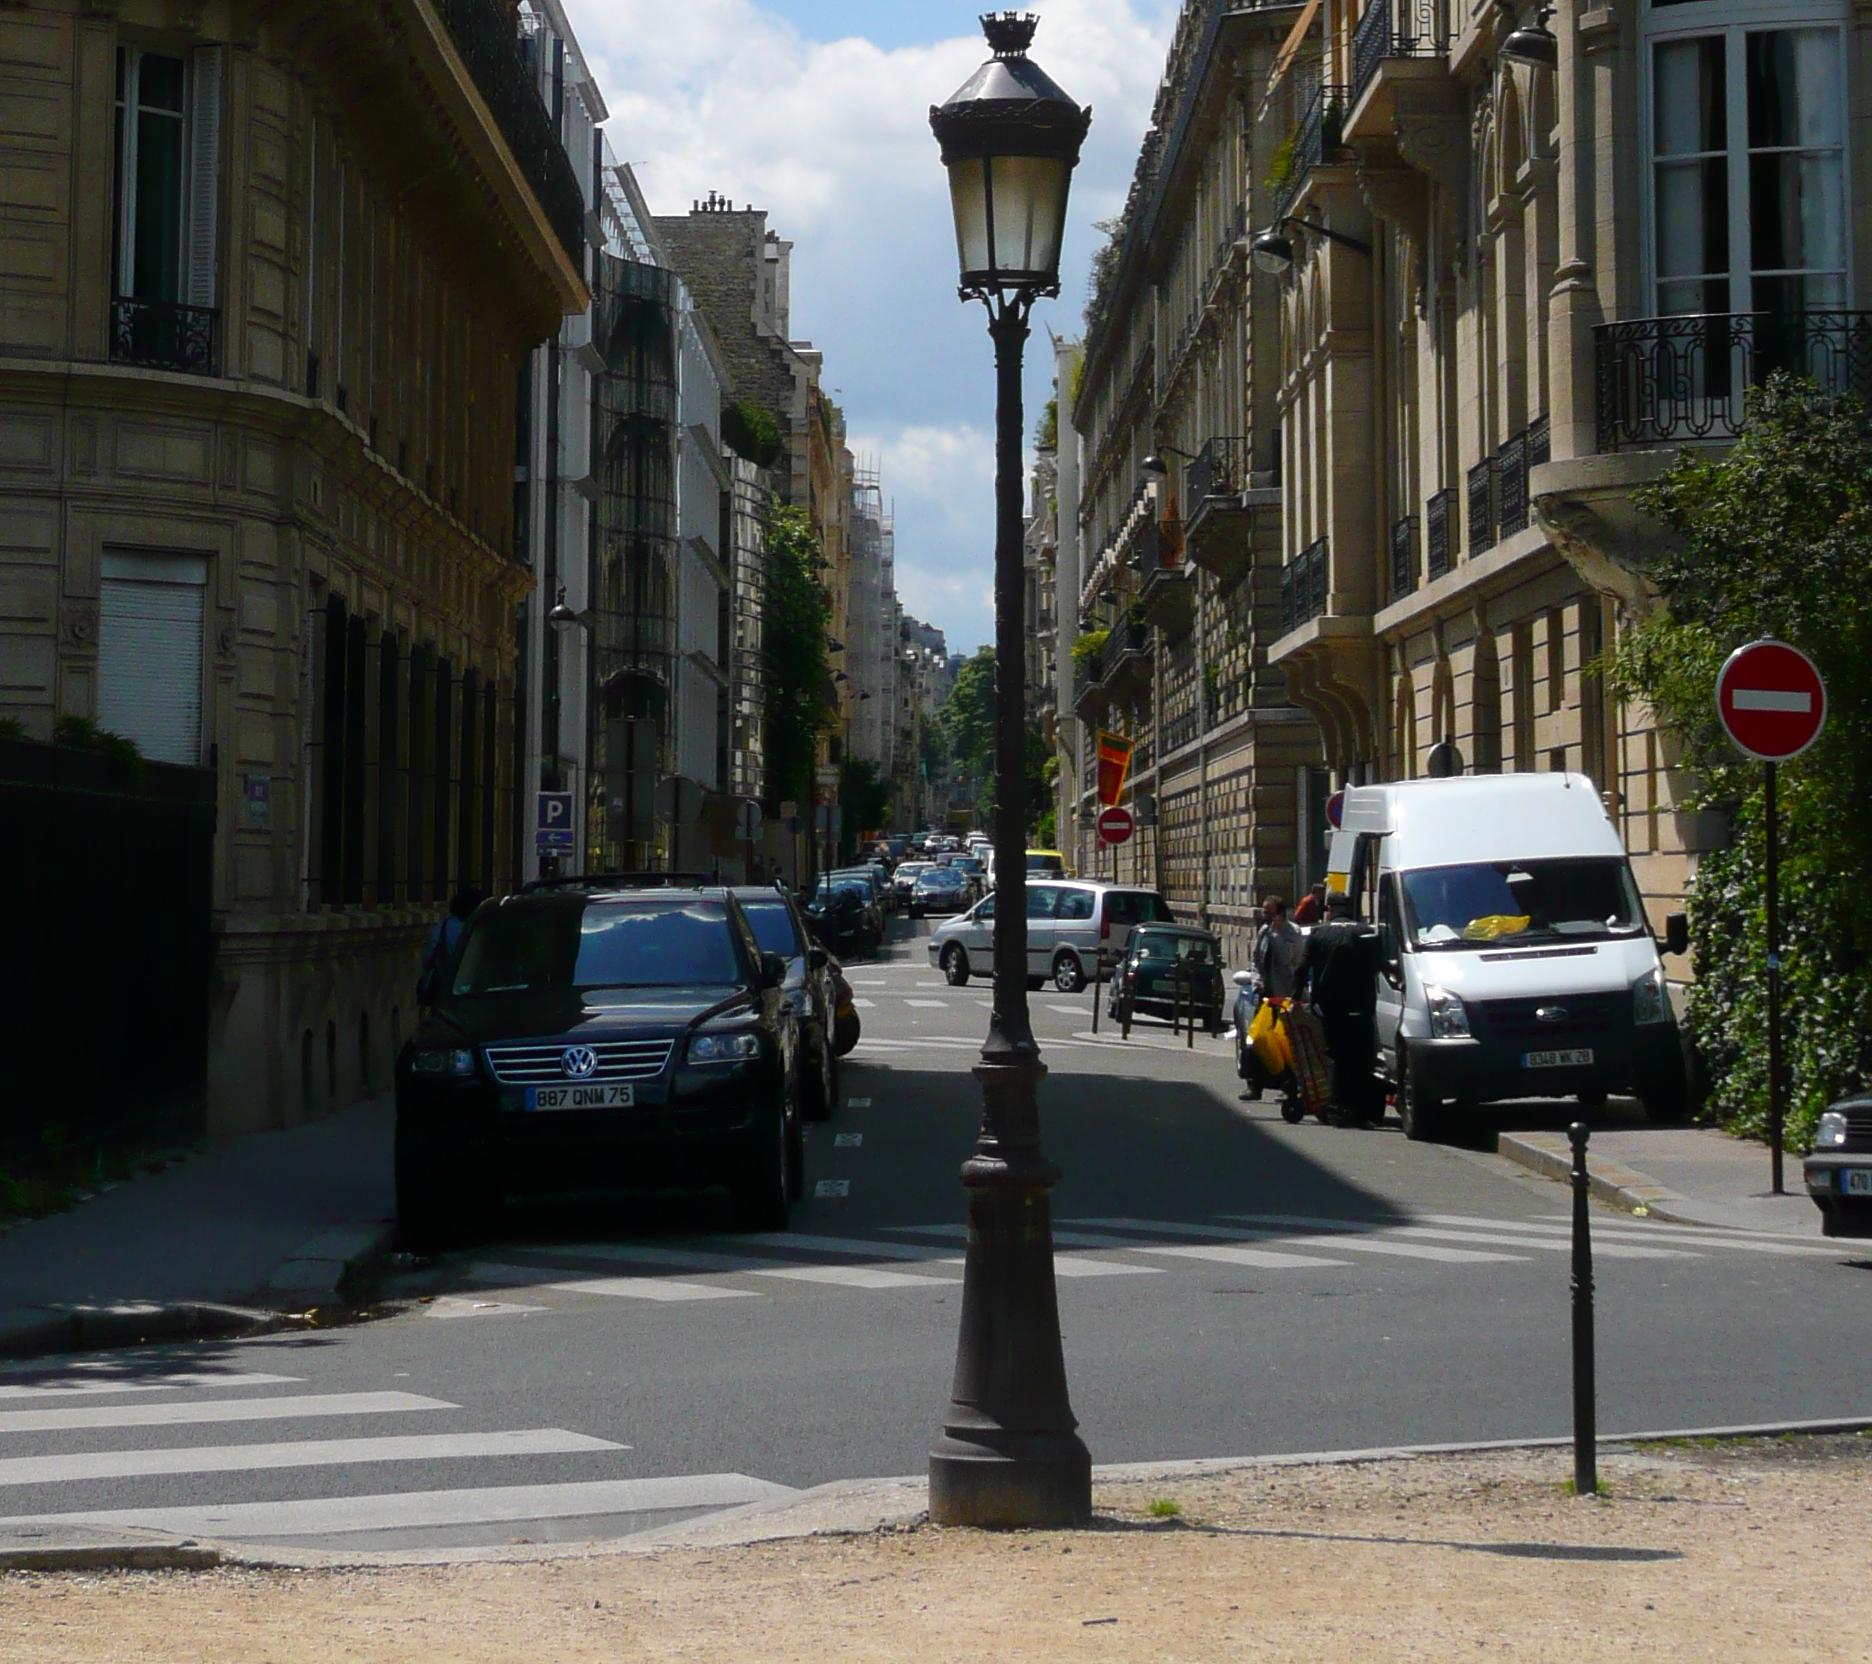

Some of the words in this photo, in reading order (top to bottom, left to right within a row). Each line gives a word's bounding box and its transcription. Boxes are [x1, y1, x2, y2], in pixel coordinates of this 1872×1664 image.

[547, 800, 563, 823] P
[537, 1089, 568, 1108] 887
[573, 1088, 605, 1106] QNM
[609, 1086, 630, 1104] 75
